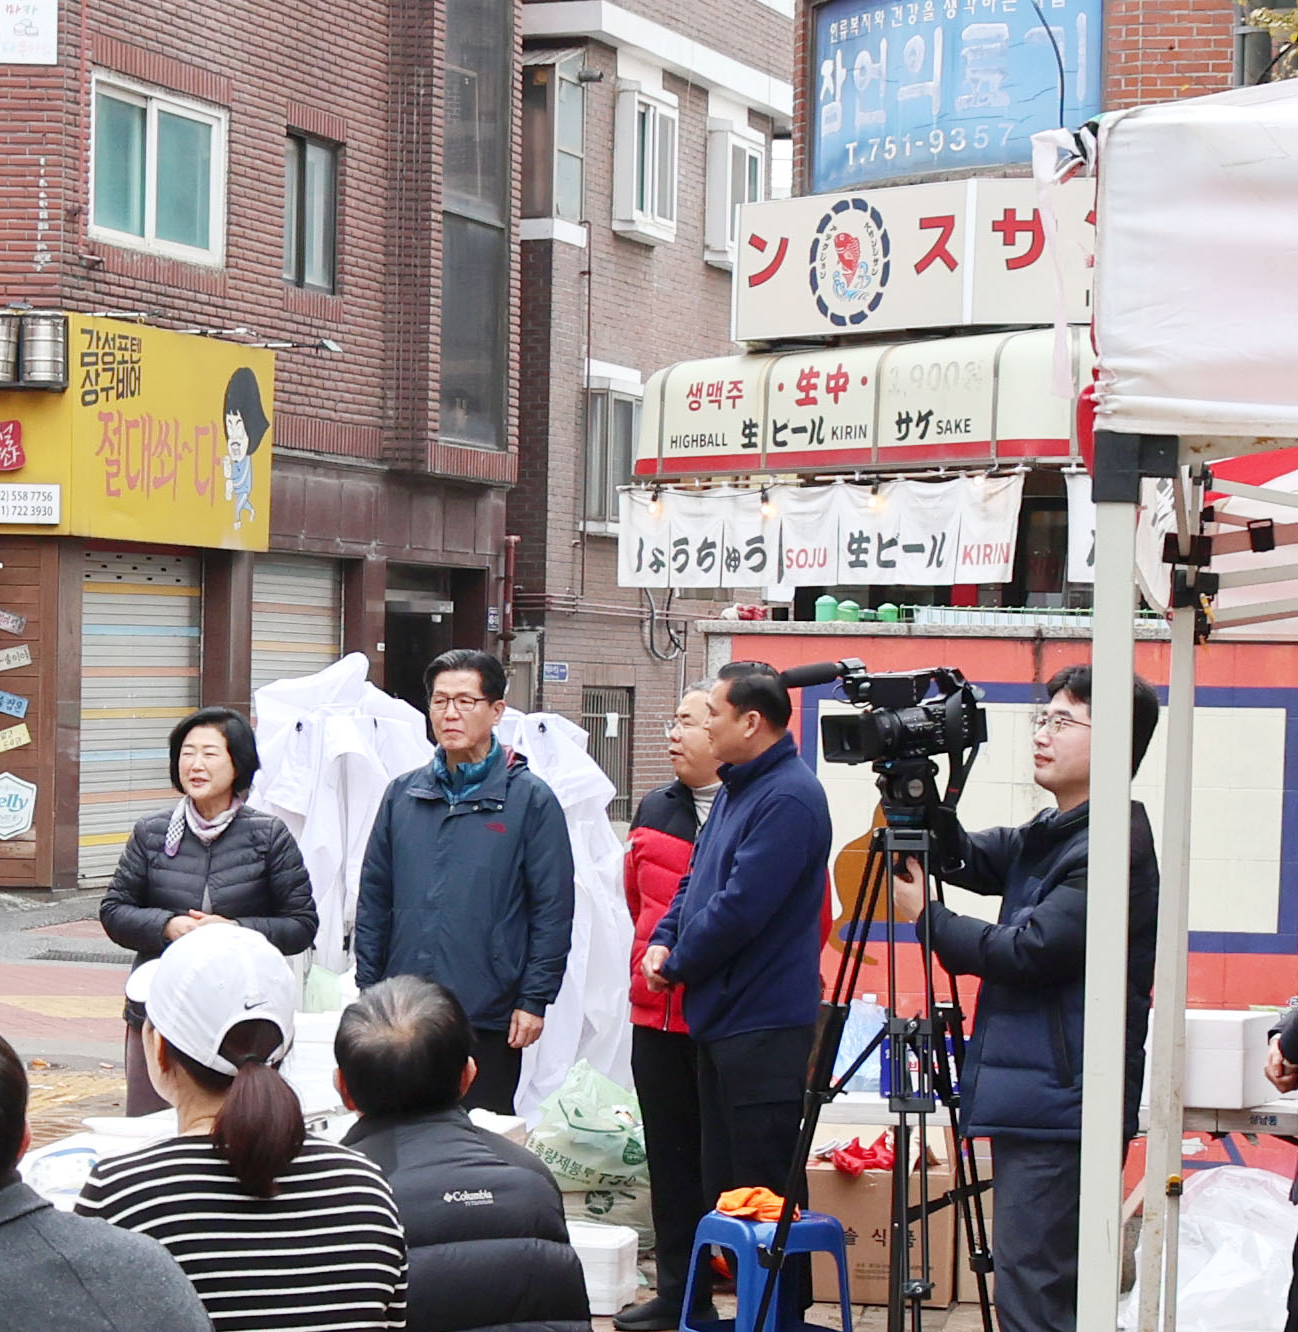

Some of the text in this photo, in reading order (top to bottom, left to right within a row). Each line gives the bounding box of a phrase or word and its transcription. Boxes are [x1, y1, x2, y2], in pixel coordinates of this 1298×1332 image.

[891, 1, 935, 28] 건강을
[81, 327, 143, 368] 감성포텐
[81, 365, 142, 407] 상구비어
[686, 380, 744, 412] 생맥주
[830, 424, 868, 441] KIRIN
[895, 409, 971, 442] サケ SAKE
[670, 432, 729, 449] HIGHBALL
[12, 490, 28, 501] 558
[30, 491, 53, 502] 7756
[12, 506, 28, 516] 722
[30, 506, 53, 516] 3930
[785, 547, 828, 570] SOJU
[847, 531, 946, 570] 生ビール
[961, 542, 1011, 567] KIRIN
[453, 1189, 493, 1202] Columbia
